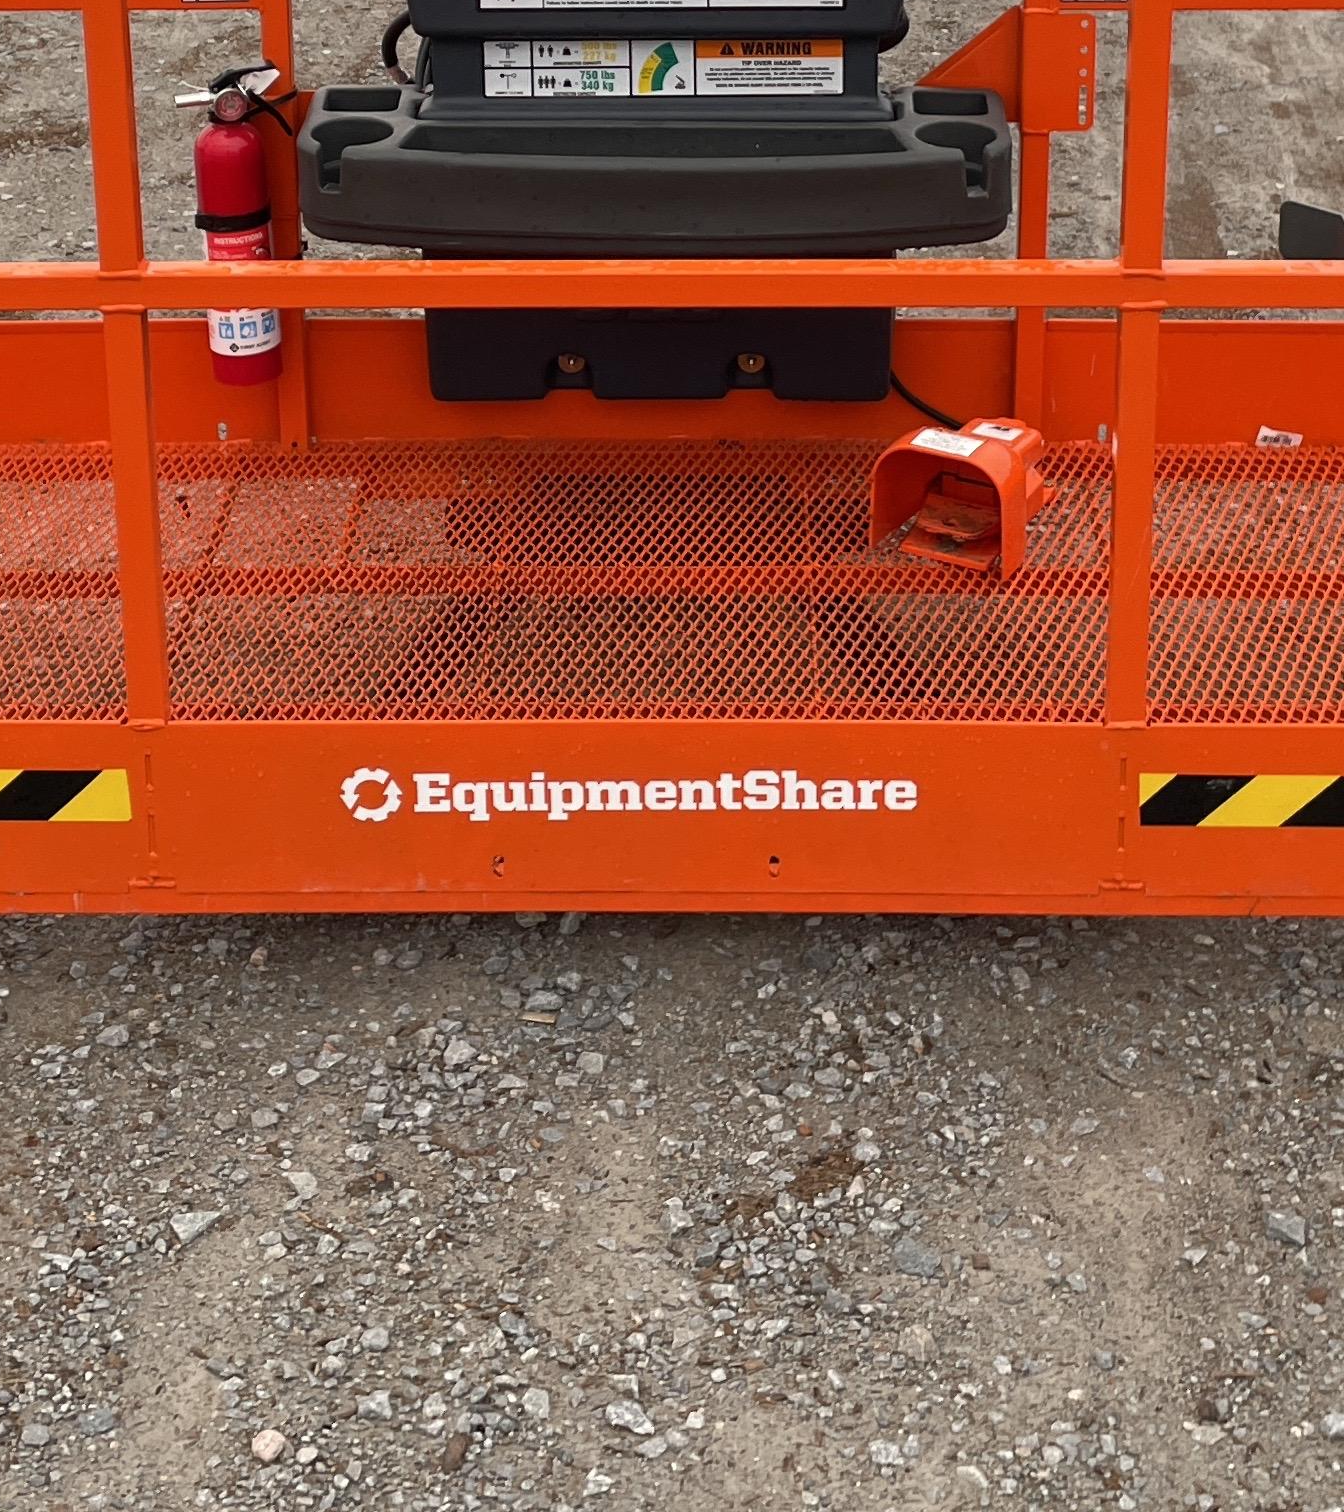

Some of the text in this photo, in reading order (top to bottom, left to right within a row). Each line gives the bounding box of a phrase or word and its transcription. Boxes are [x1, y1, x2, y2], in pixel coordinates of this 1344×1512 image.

[741, 42, 812, 56] WARNING
[580, 70, 616, 80] 750 lbs
[581, 80, 614, 92] 340 kg
[214, 232, 263, 245] INSTRUCTIONS
[413, 769, 918, 821] EquipmentShare
